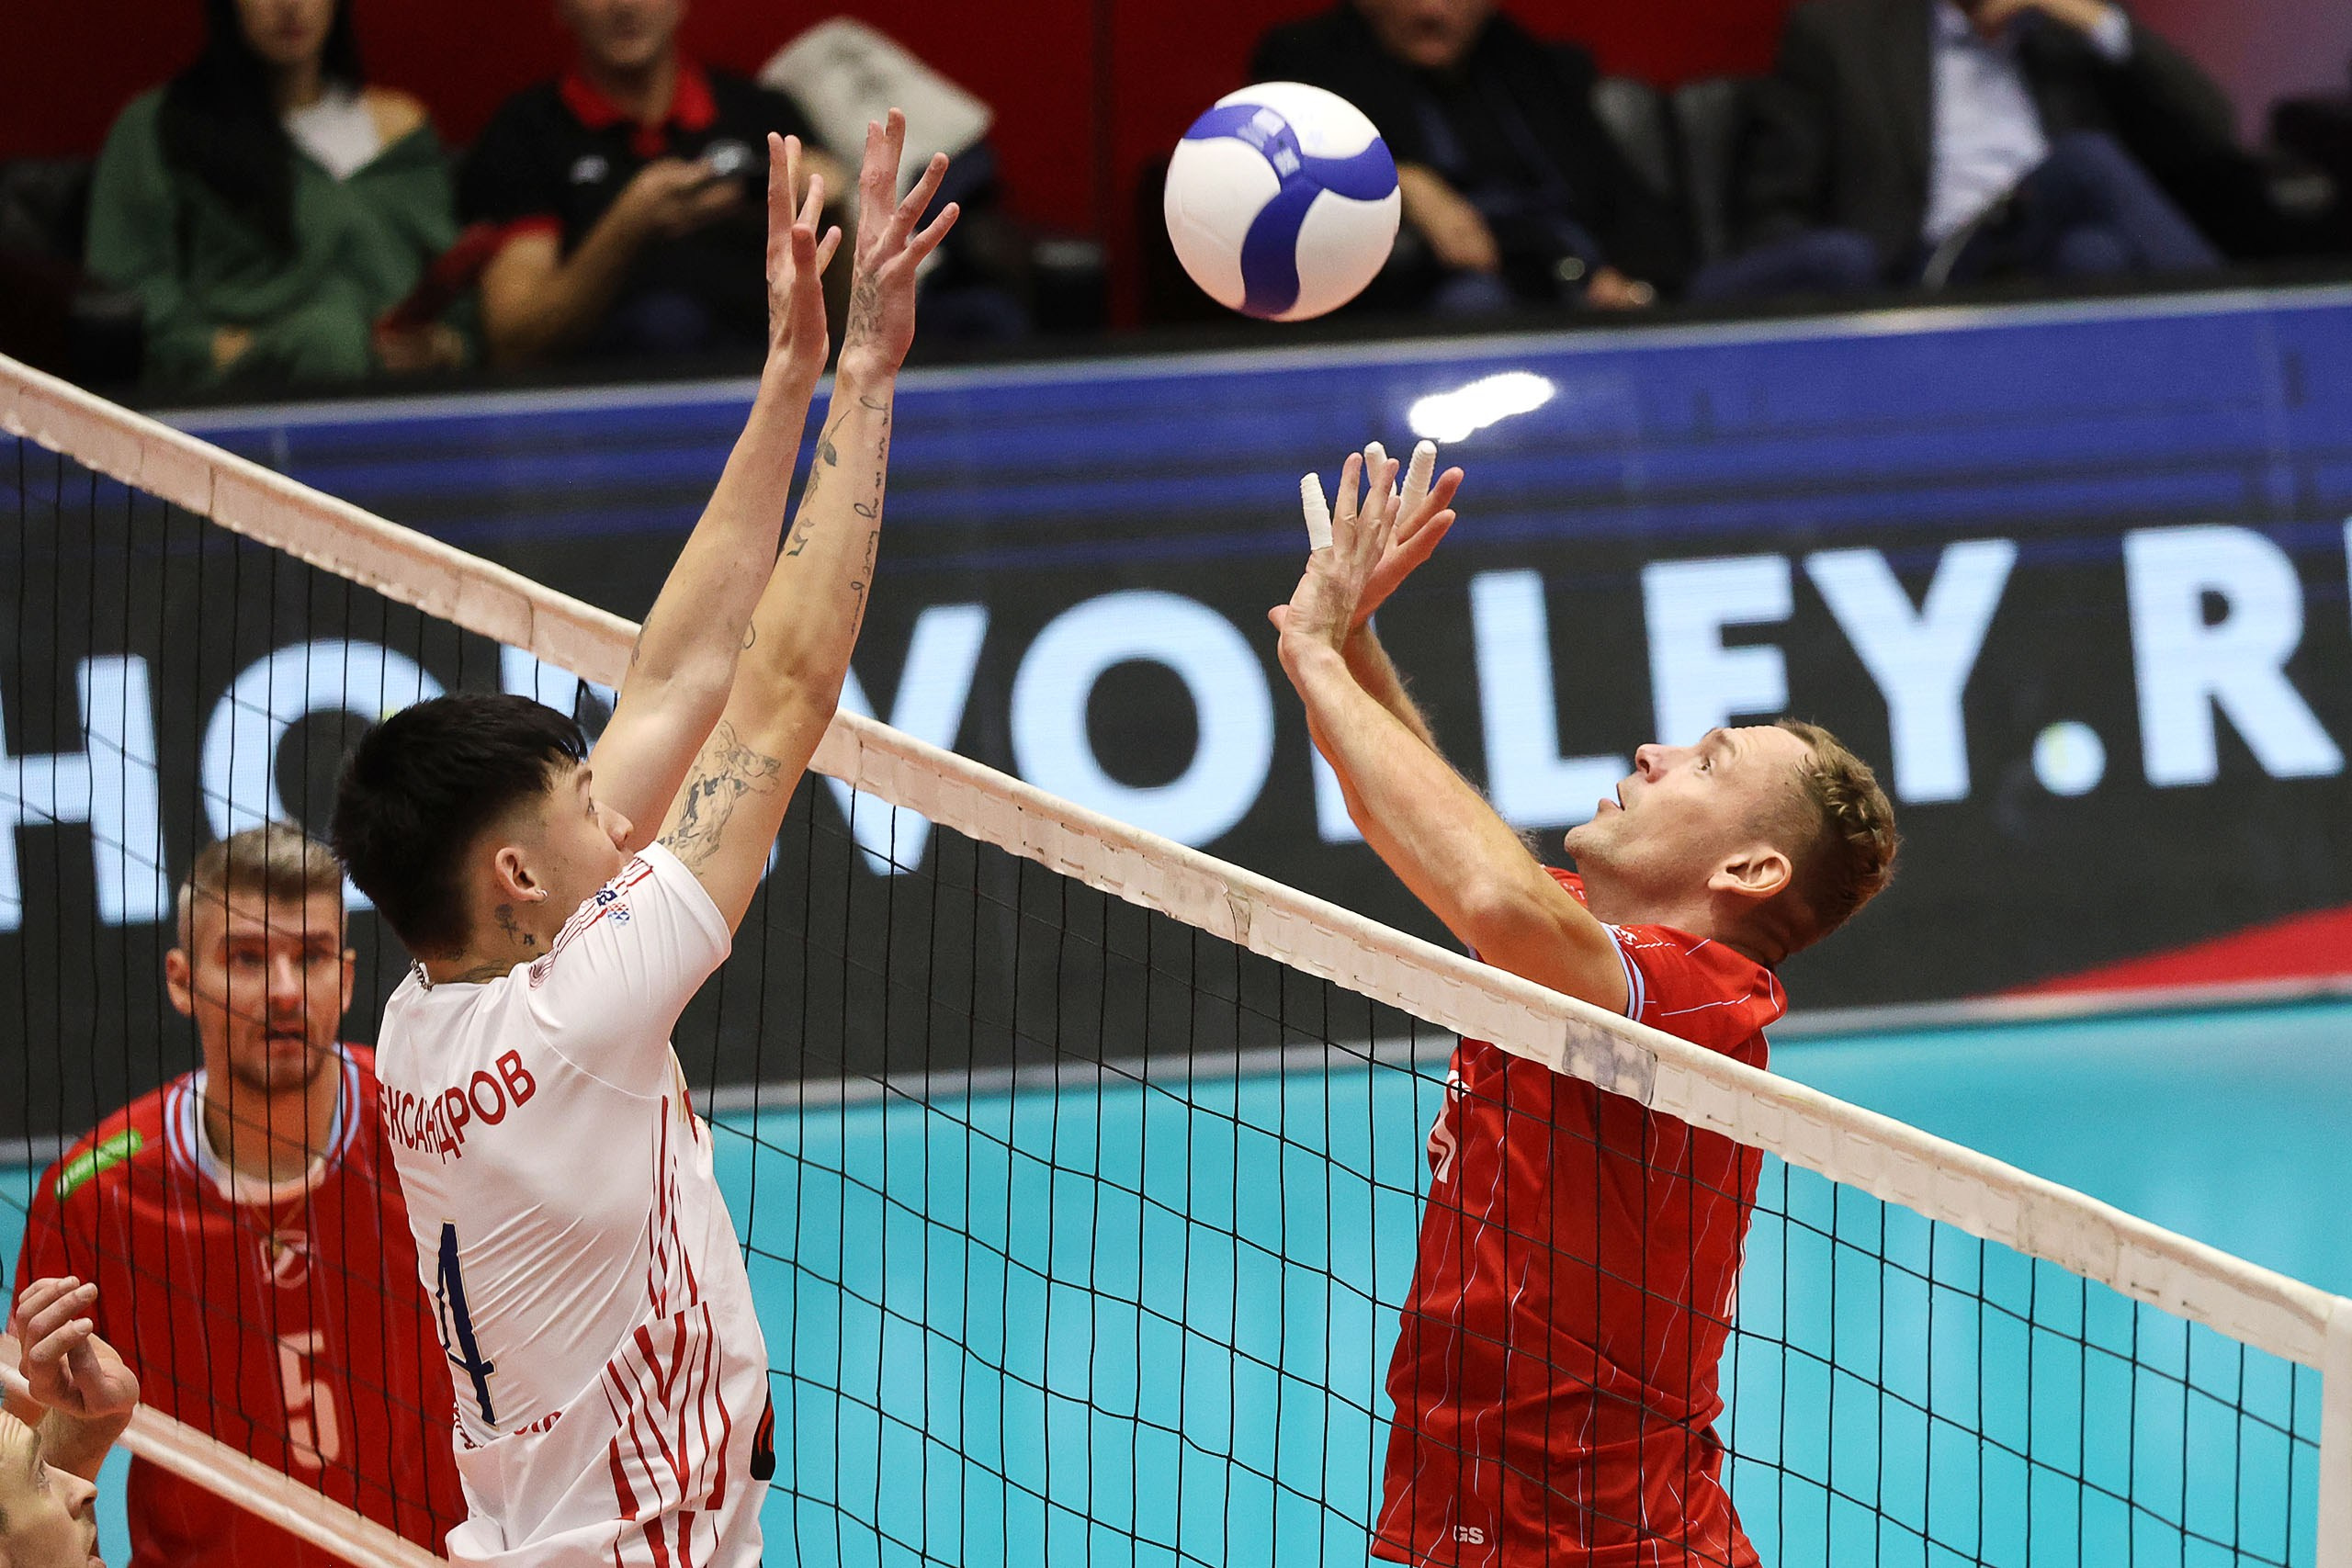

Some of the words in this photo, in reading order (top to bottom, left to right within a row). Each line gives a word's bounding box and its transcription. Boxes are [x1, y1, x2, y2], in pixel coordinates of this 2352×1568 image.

[435, 1220, 497, 1430] 4
[277, 1330, 341, 1468] 5
[1453, 1525, 1485, 1545] GS
